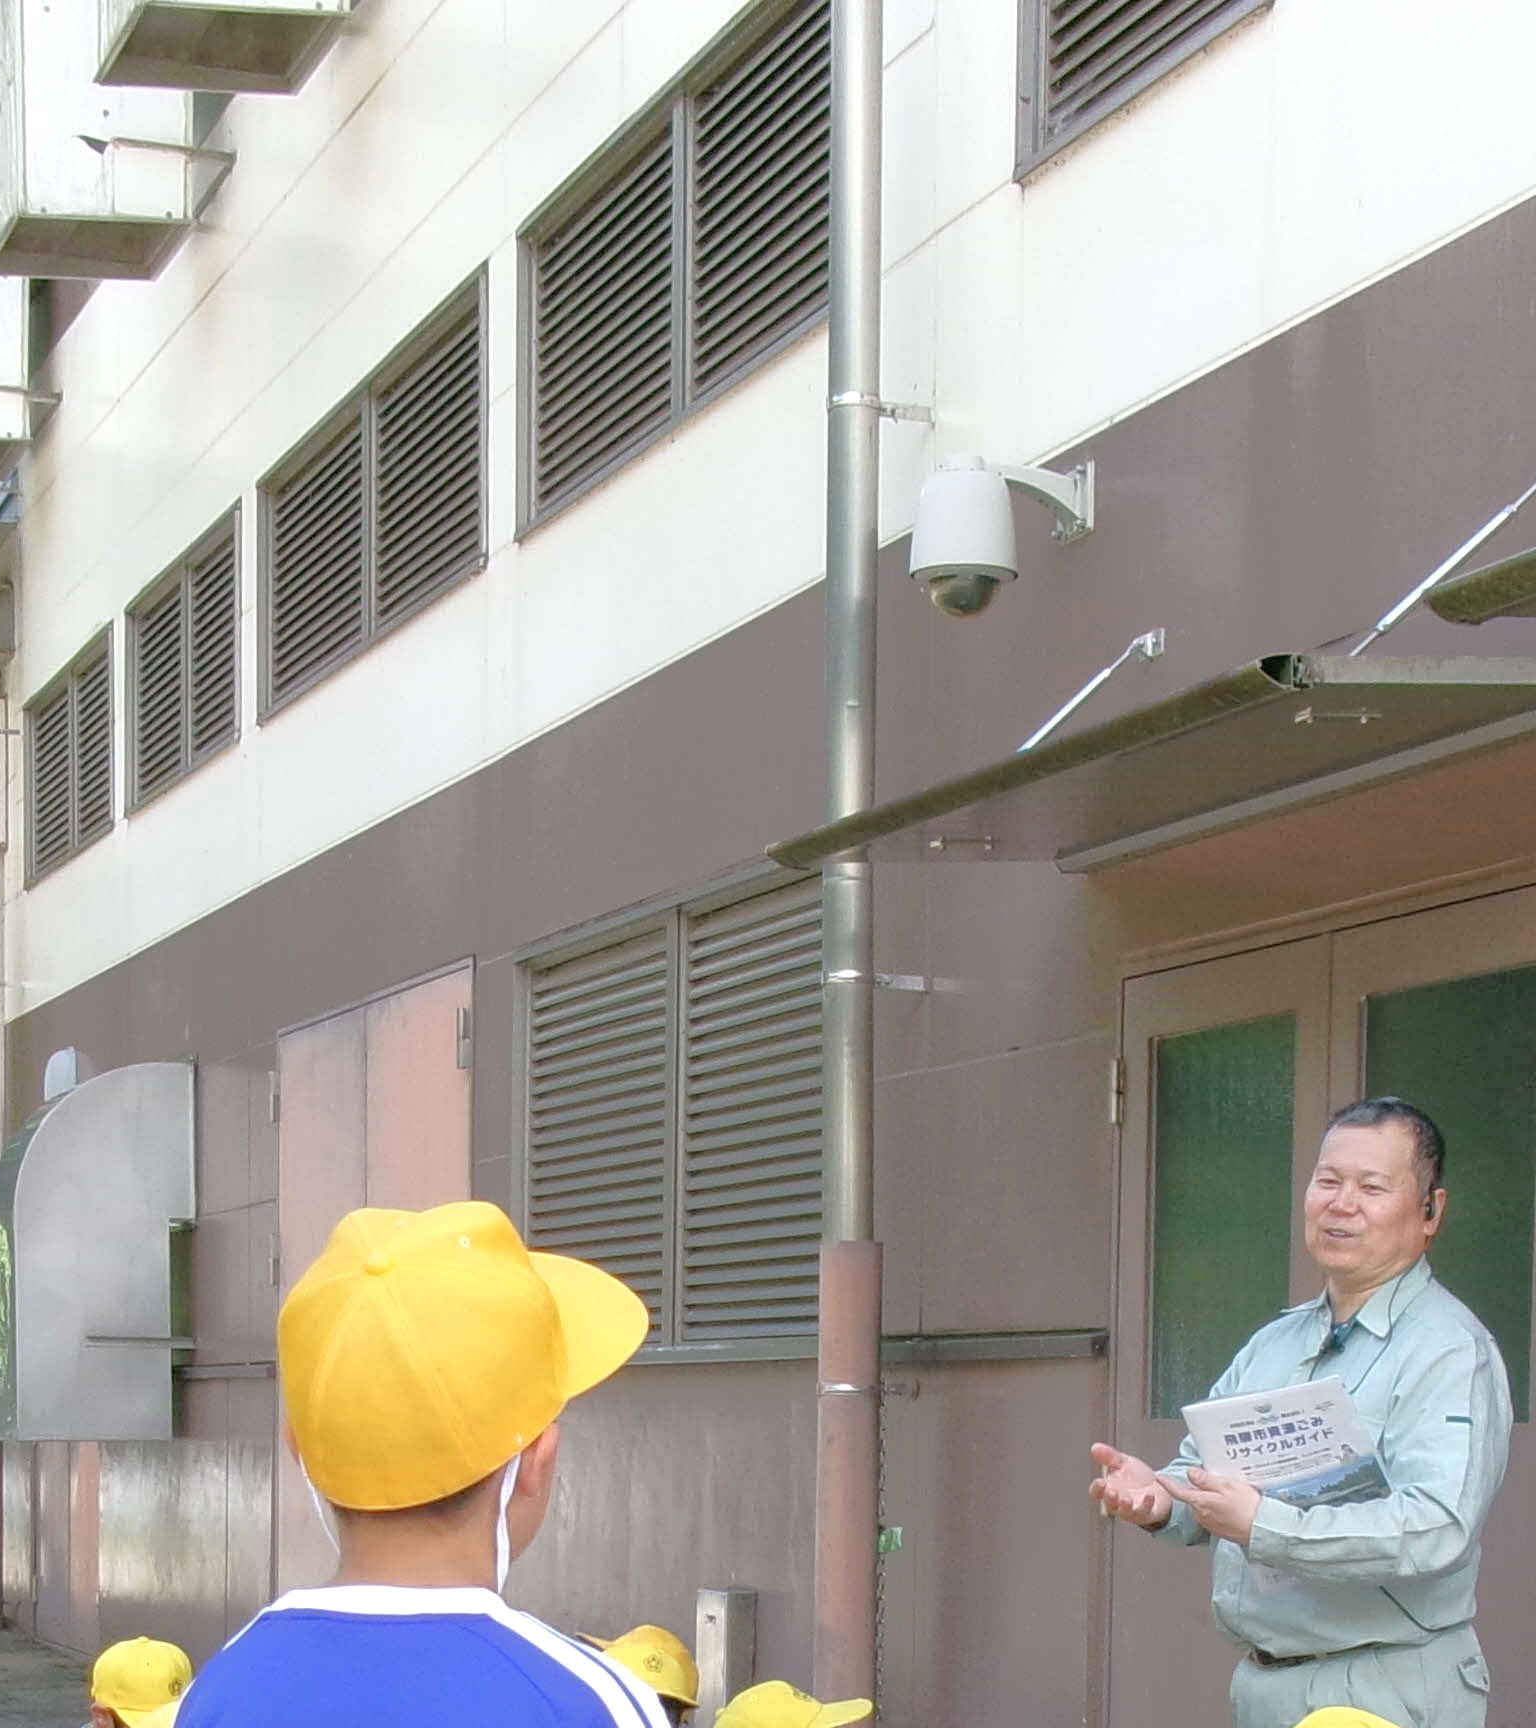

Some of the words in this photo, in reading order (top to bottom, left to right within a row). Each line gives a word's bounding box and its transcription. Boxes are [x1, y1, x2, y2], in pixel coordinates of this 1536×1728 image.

[1225, 1427, 1334, 1460] リサイクルガイド
